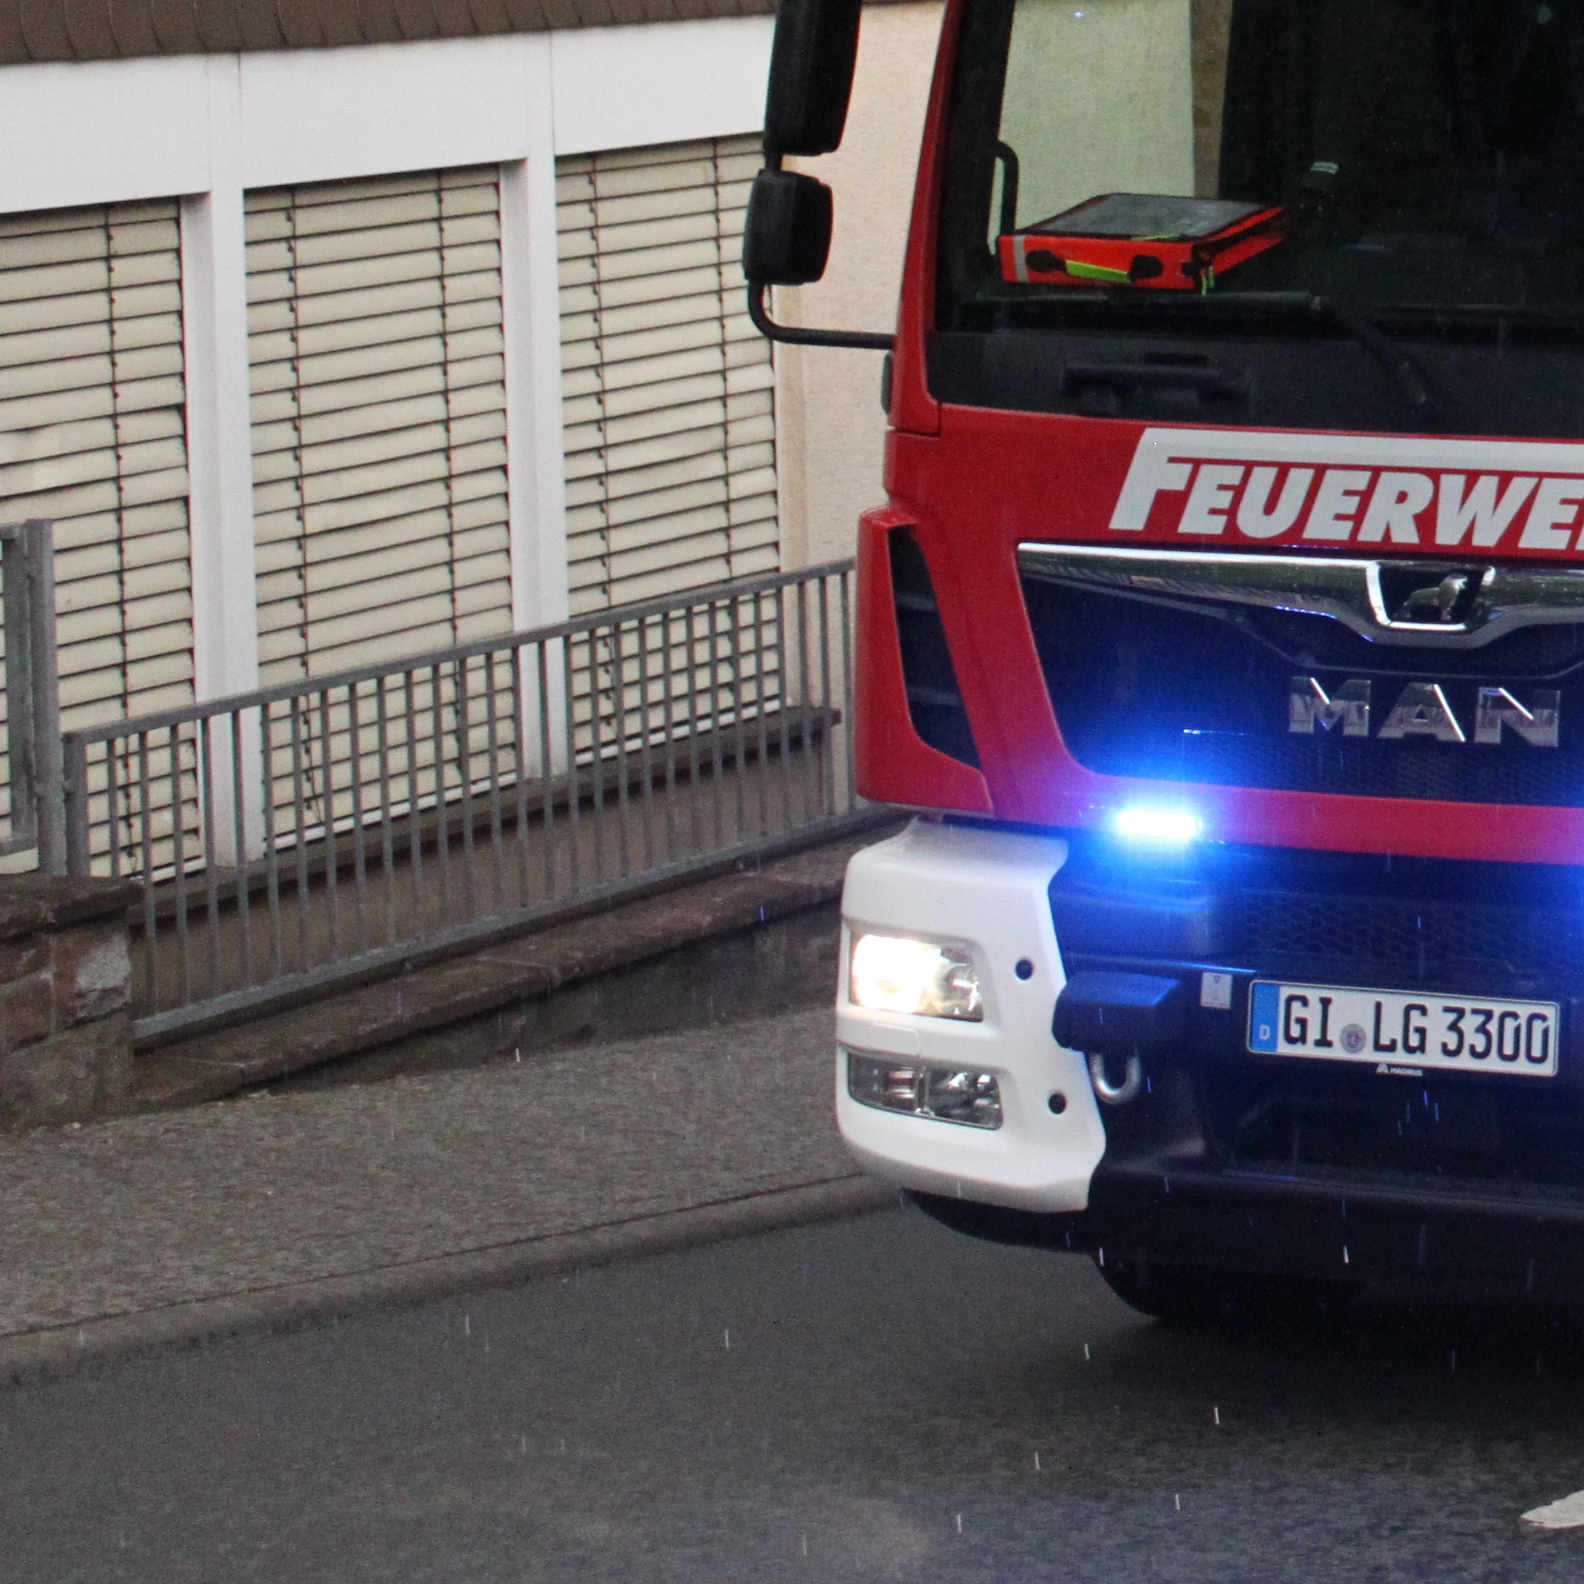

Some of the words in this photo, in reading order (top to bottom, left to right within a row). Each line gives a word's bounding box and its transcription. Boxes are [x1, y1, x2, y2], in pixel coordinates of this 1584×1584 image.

[1289, 677, 1559, 747] MAN
[1259, 1024, 1271, 1041] D
[1283, 994, 1334, 1047] GI
[1373, 1001, 1428, 1054] LG
[1440, 1006, 1551, 1064] 3300
